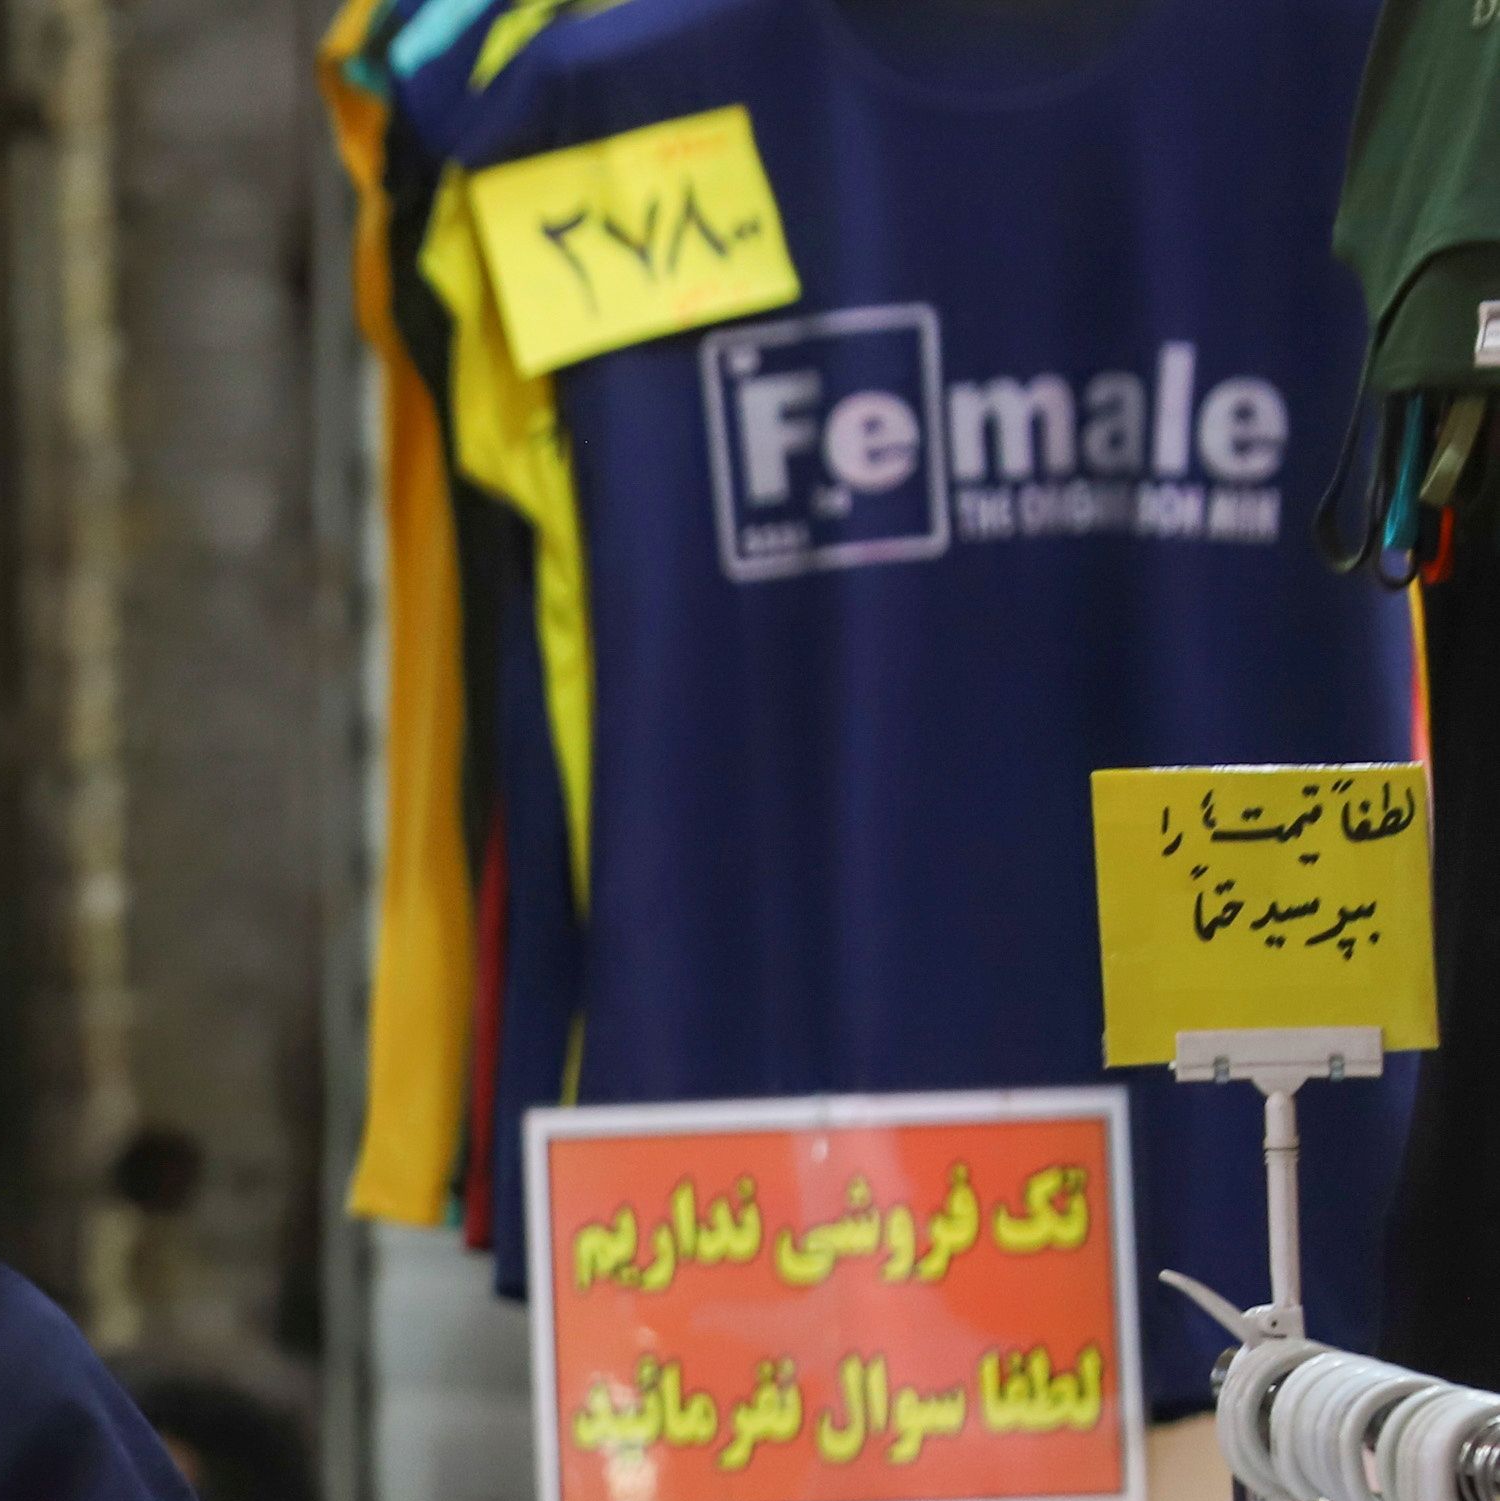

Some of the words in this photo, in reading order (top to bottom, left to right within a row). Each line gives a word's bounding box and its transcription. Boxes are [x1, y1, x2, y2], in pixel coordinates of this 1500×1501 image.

[1160, 807, 1184, 857] را
[1249, 897, 1381, 961] بپرسید
[573, 1176, 762, 1290] نداریم
[776, 1164, 980, 1285] فروشی
[993, 1164, 1090, 1255] تک
[816, 1353, 967, 1465] سوال
[978, 1347, 1102, 1434] لطفا
